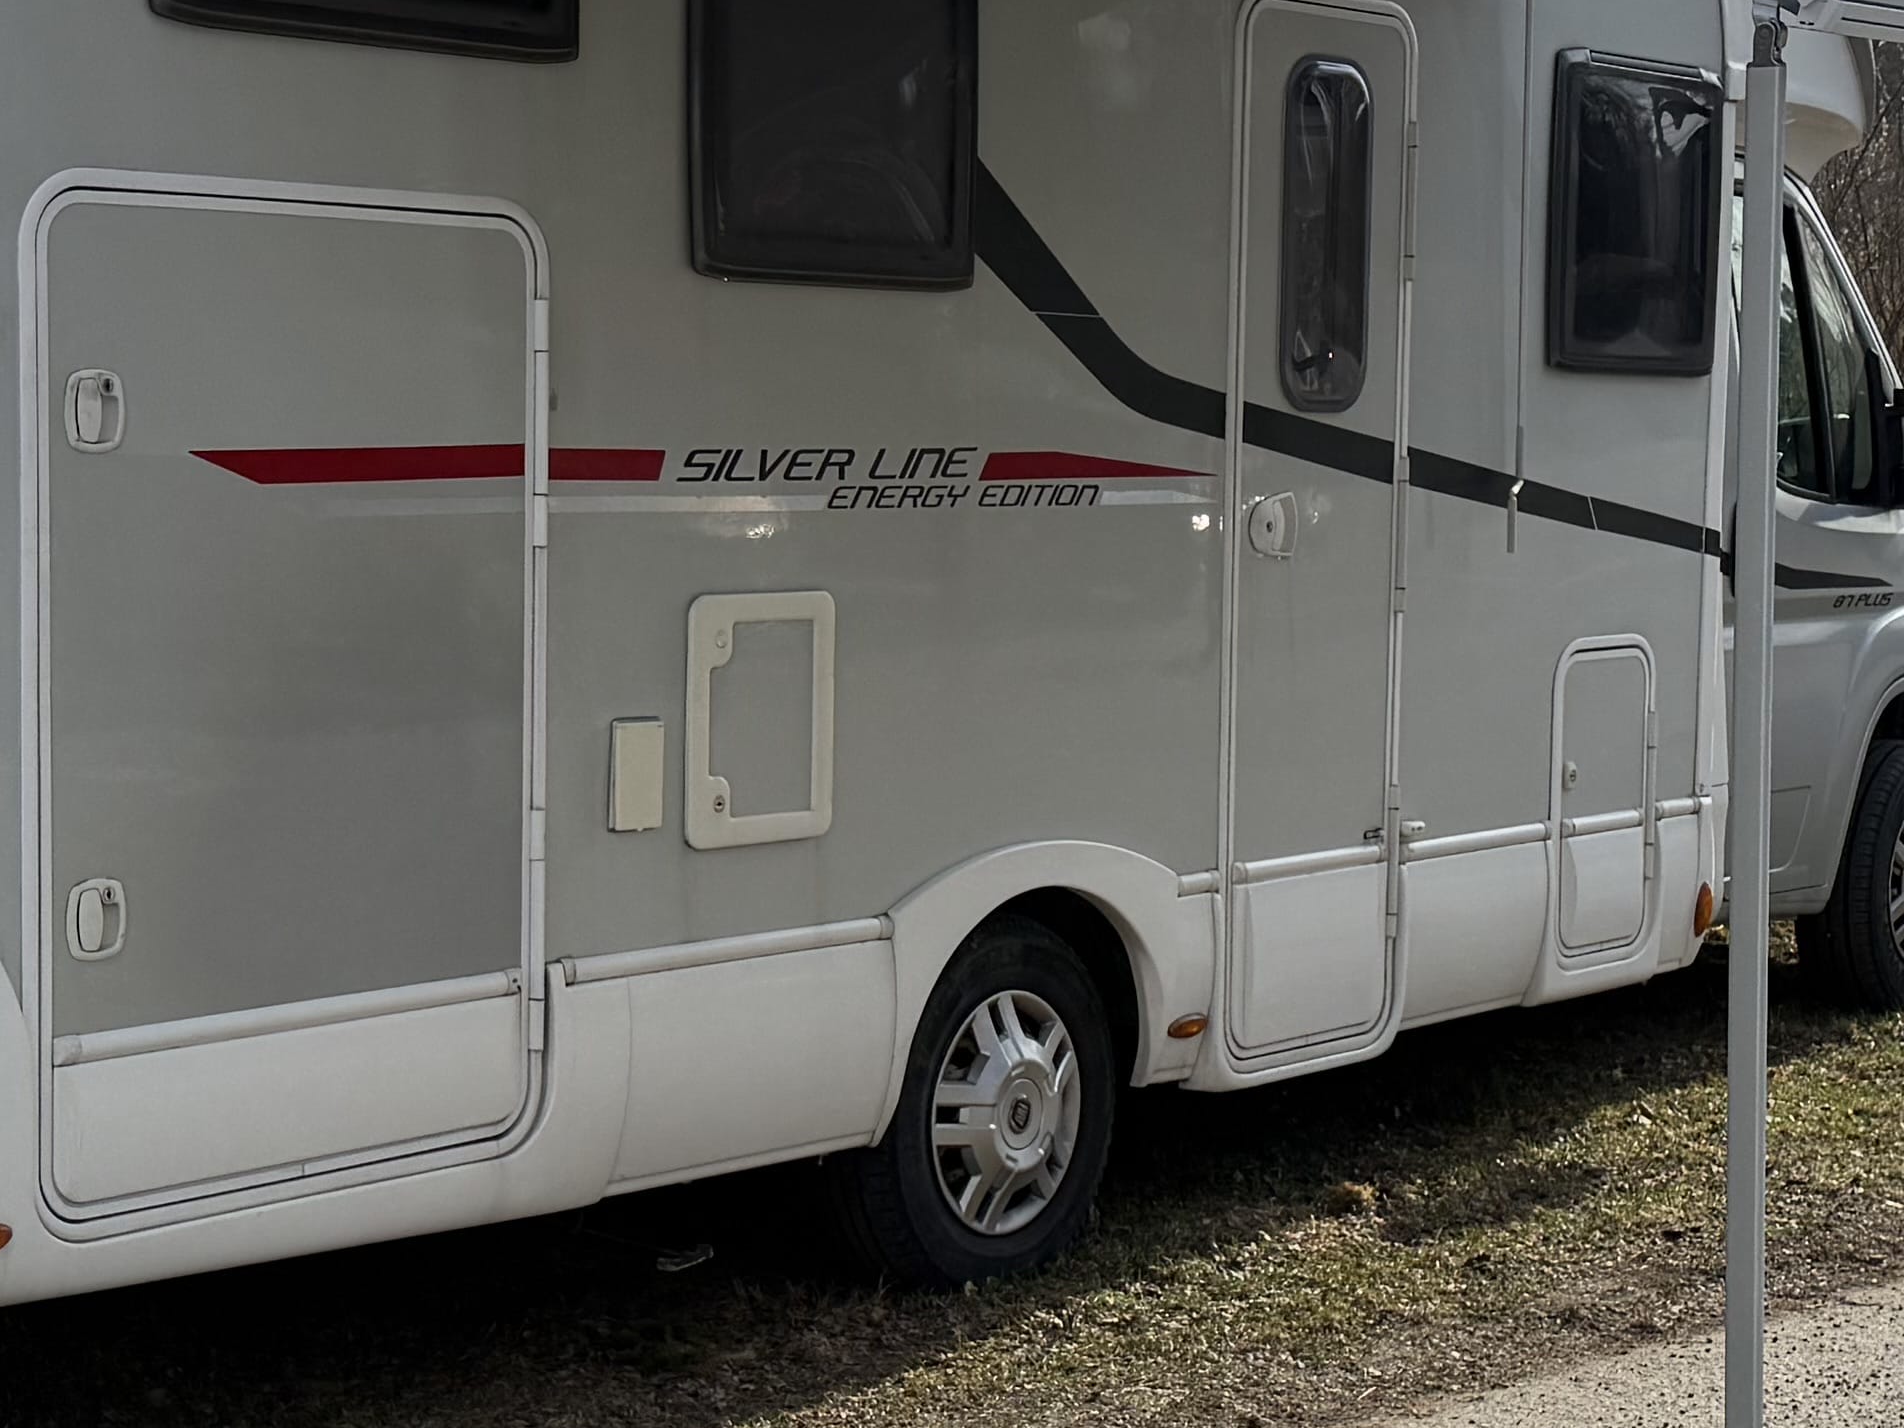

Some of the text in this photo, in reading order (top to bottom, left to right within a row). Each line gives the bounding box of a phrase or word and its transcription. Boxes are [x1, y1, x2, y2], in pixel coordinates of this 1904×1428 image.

[676, 446, 978, 482] SILVER LINE
[827, 484, 1099, 509] ENERGY EDITION
[1854, 592, 1894, 607] PLUS
